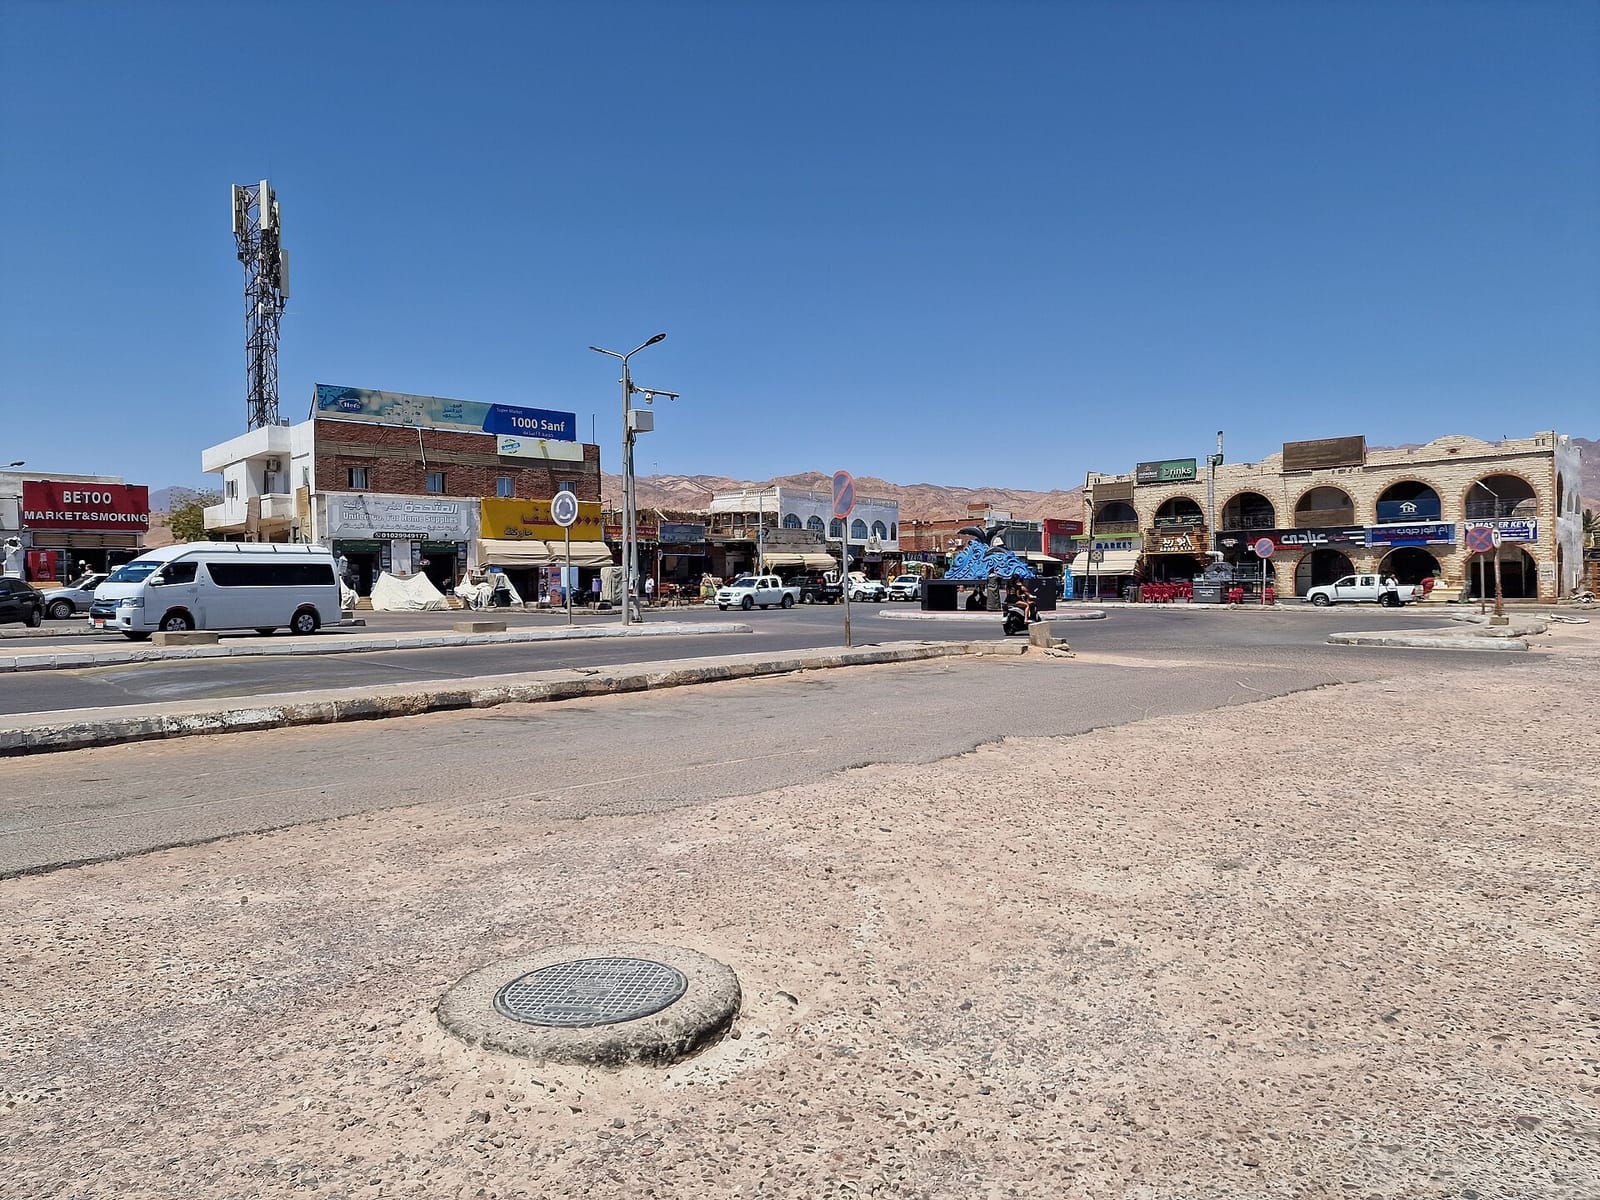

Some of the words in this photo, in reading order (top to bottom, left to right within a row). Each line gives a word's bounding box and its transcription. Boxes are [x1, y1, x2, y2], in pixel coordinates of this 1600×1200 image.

[511, 416, 538, 429] 1000
[540, 419, 565, 432] Sanf
[63, 490, 112, 504] BETOO
[404, 501, 458, 514] المتحدة
[24, 511, 148, 522] MARKET&SMOKING
[1475, 521, 1508, 529] MASER
[1095, 541, 1132, 550] MARKET
